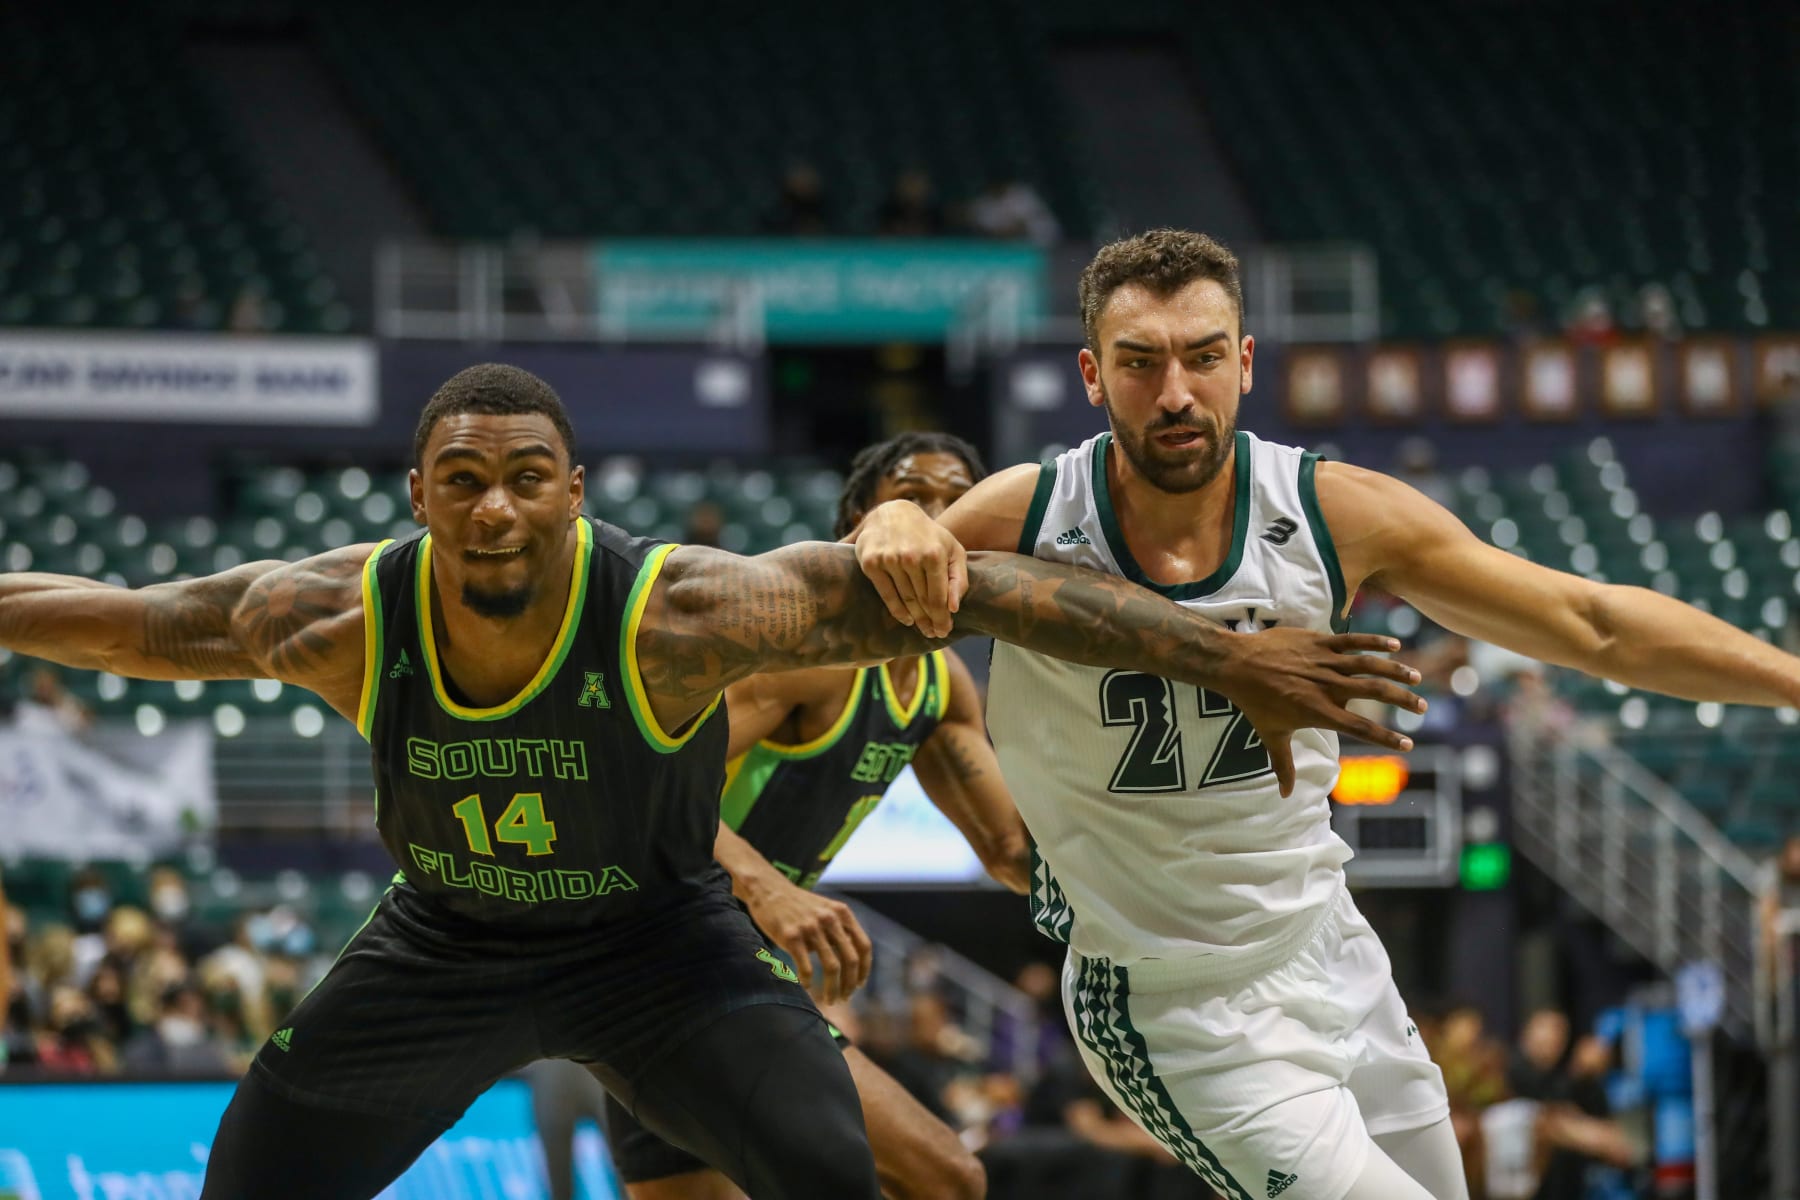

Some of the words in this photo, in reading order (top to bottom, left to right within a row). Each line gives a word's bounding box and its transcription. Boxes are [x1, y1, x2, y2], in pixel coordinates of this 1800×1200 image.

[578, 672, 611, 709] A
[1100, 668, 1273, 793] 22
[407, 737, 588, 781] SOUTH
[453, 792, 557, 857] 14
[409, 843, 639, 902] FLORIDA
[1267, 1173, 1298, 1199] adidas
